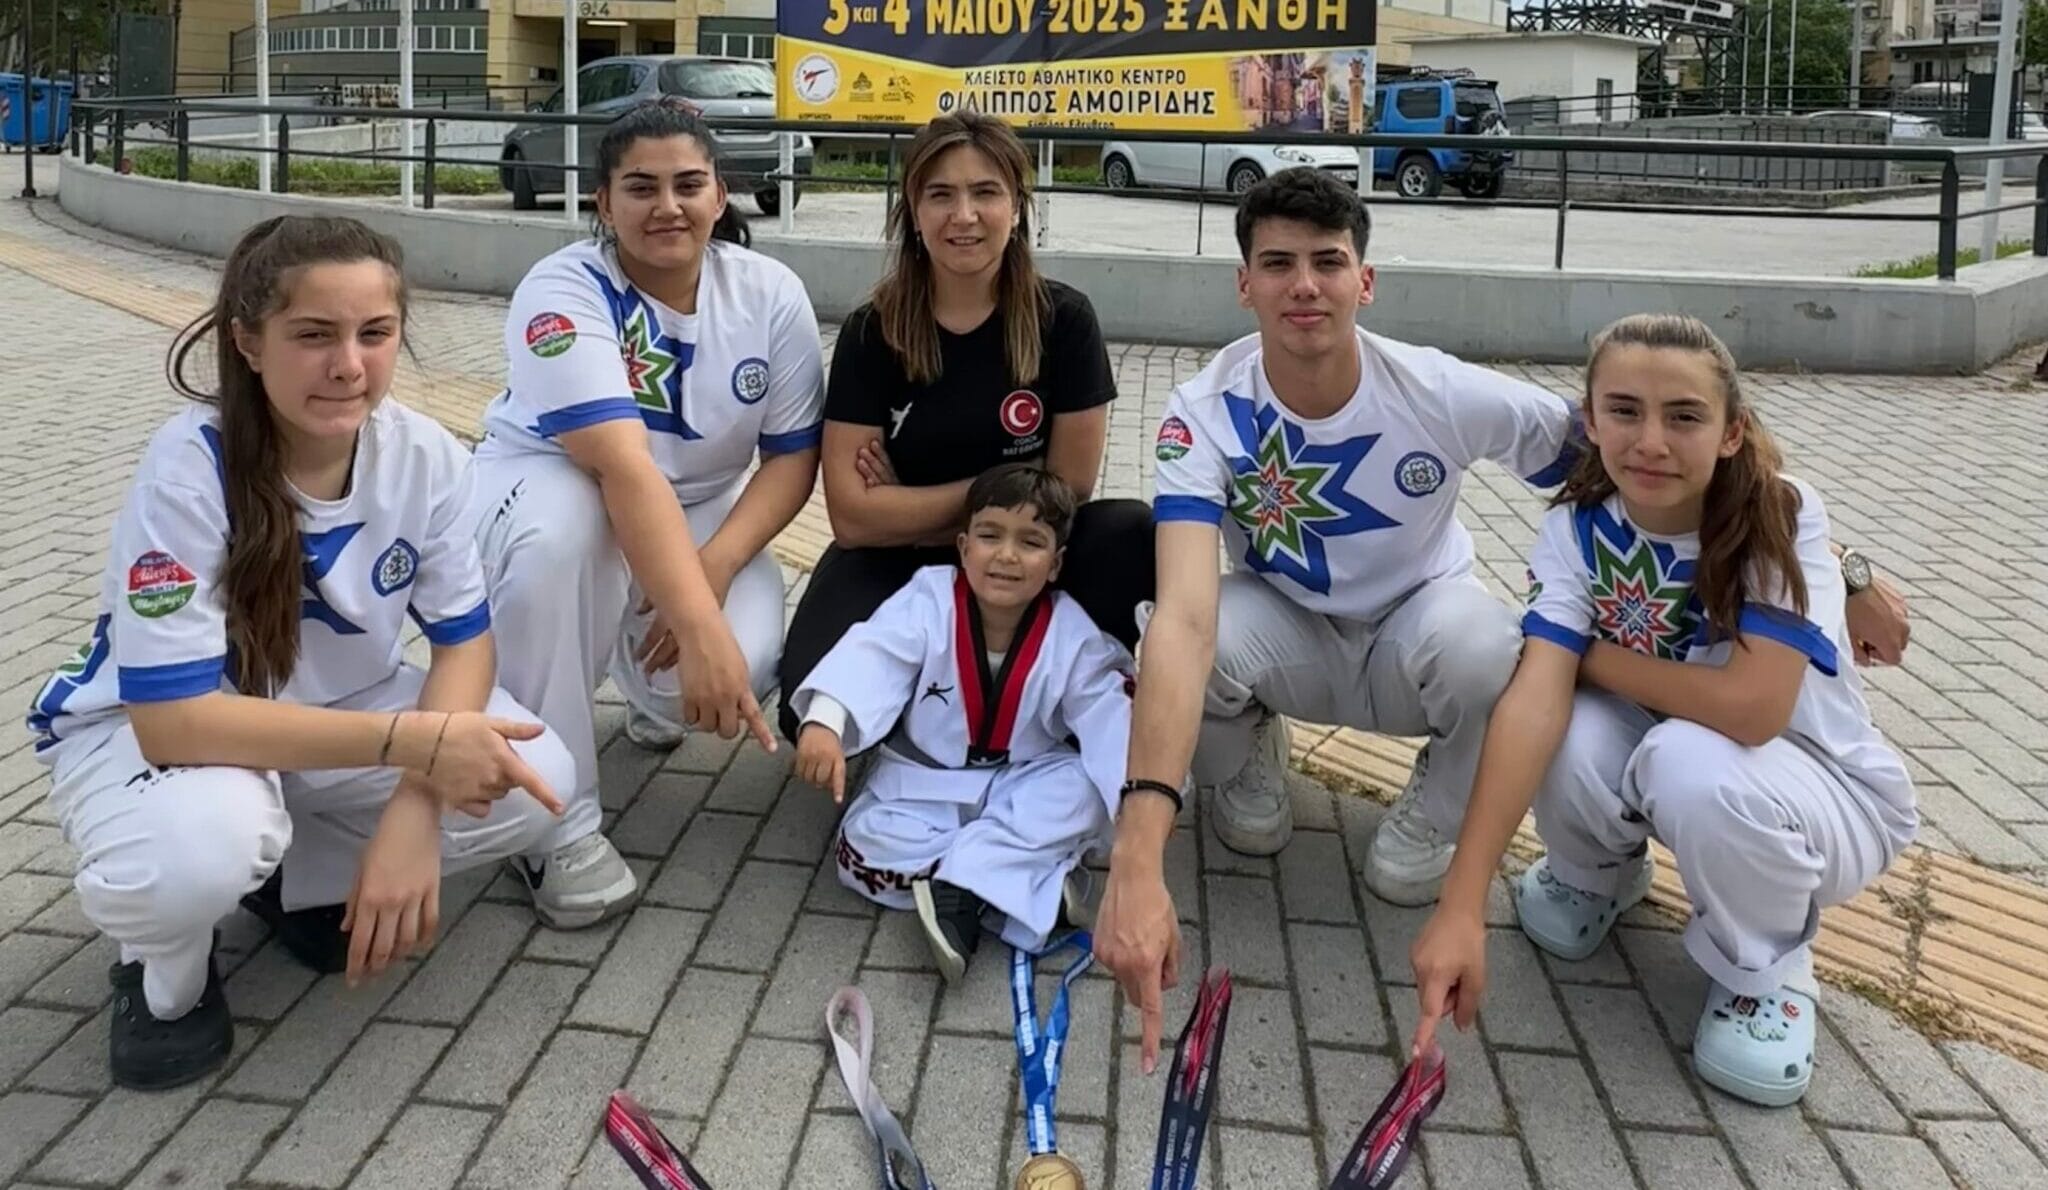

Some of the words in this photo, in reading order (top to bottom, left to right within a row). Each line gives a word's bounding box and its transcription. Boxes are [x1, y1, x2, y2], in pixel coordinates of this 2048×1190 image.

[883, 0, 911, 35] 4
[1048, 0, 1145, 34] 2025
[1163, 0, 1347, 31] ΞΑΝΘΗ
[965, 70, 1026, 85] ΚΛΕΙΣΤΟ
[1033, 69, 1114, 85] ΑΘΛΗΤΙΚΟ
[1121, 69, 1186, 84] ΚΕΝΤΡΟ
[939, 90, 1057, 114] ΦΙΛΙΠΠΟΣ
[1067, 90, 1215, 115] ΑΜΟΙΡΙΔΗΣ
